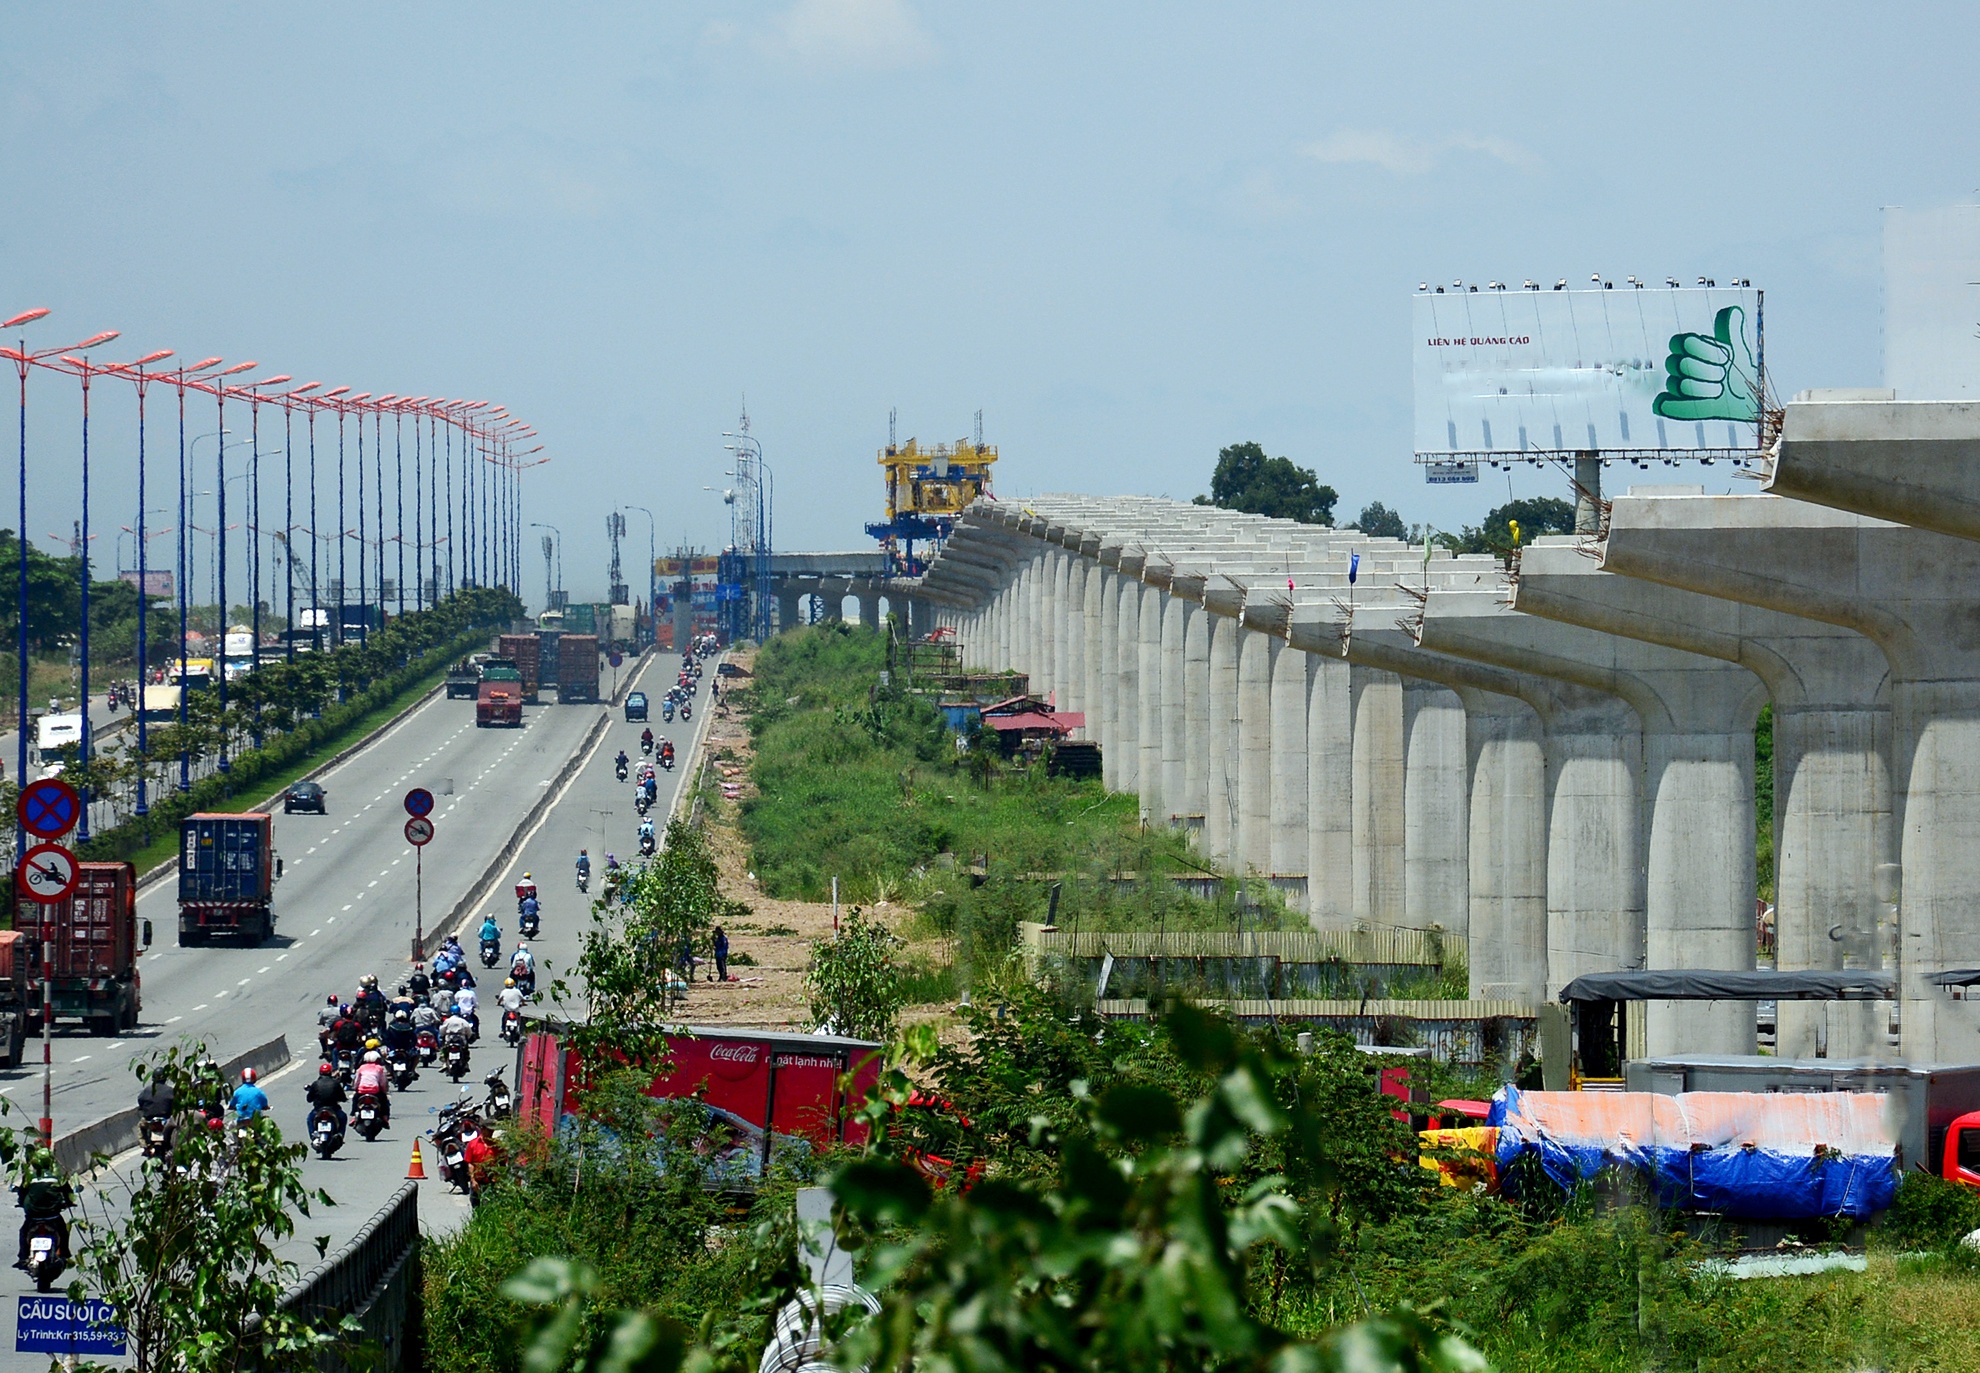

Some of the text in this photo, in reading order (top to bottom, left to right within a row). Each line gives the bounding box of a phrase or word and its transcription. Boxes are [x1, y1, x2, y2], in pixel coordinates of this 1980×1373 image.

[1427, 338, 1450, 346] LIÊN
[1453, 337, 1467, 346] HỆ
[1509, 334, 1530, 345] CÁO
[710, 1043, 760, 1063] Coca-Cola
[795, 1056, 818, 1068] lạnh
[19, 1298, 53, 1320] CẦU
[54, 1300, 94, 1322] SUỐI
